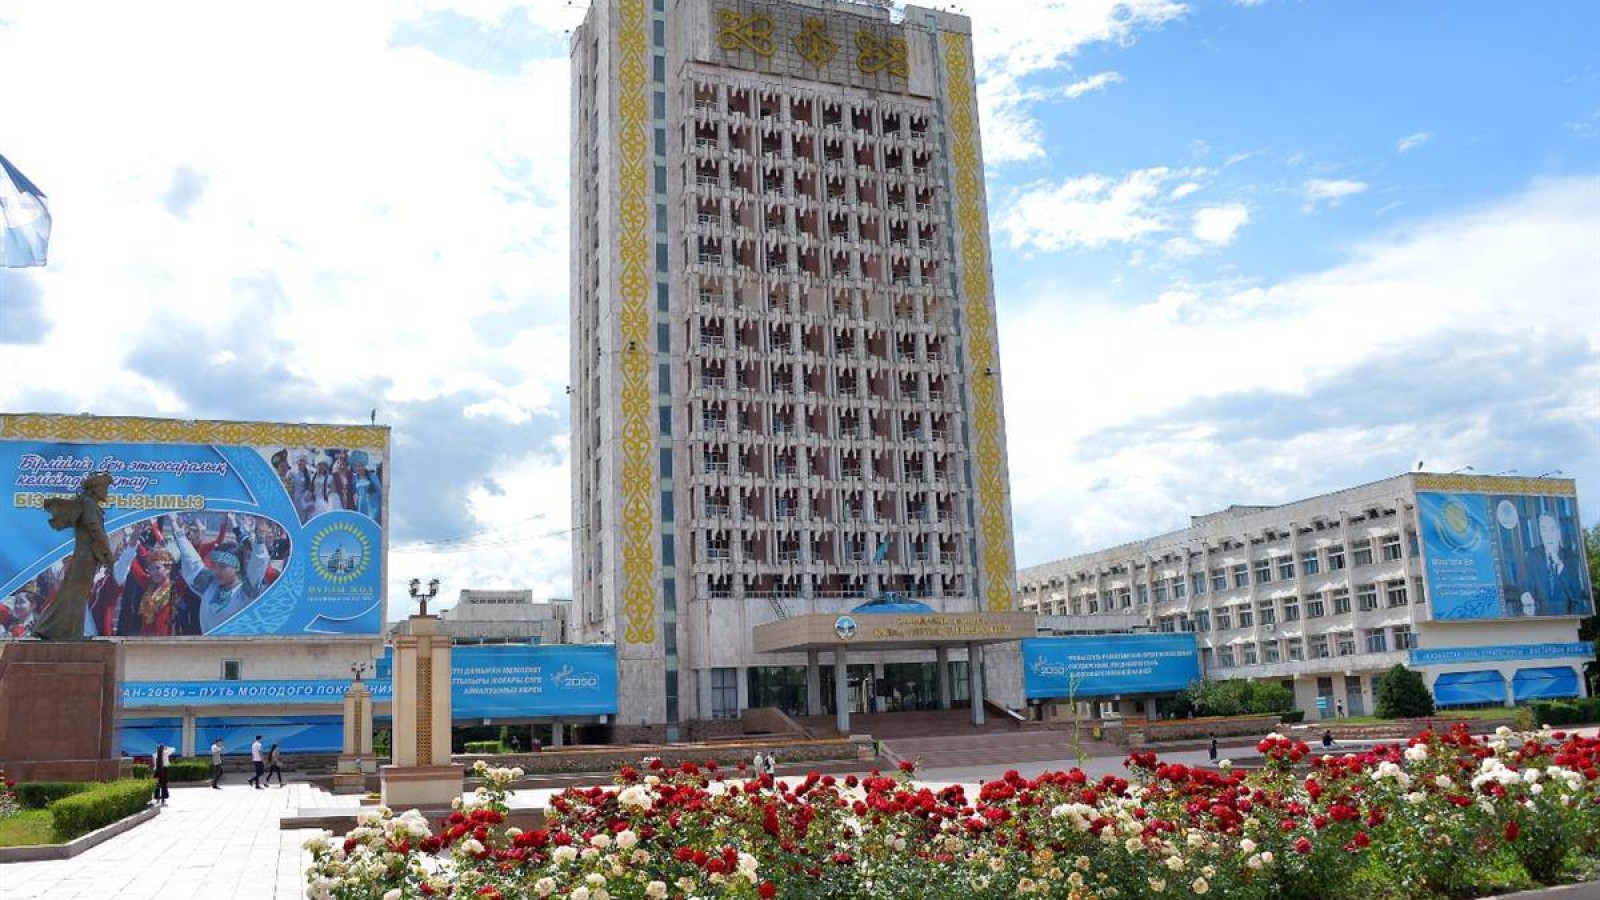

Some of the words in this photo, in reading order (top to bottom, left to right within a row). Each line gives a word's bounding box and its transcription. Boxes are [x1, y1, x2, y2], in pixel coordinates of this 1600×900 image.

[564, 678, 598, 686] 2050
[199, 687, 234, 697] ПУТЬ
[238, 684, 313, 697] МОЛОДОГО
